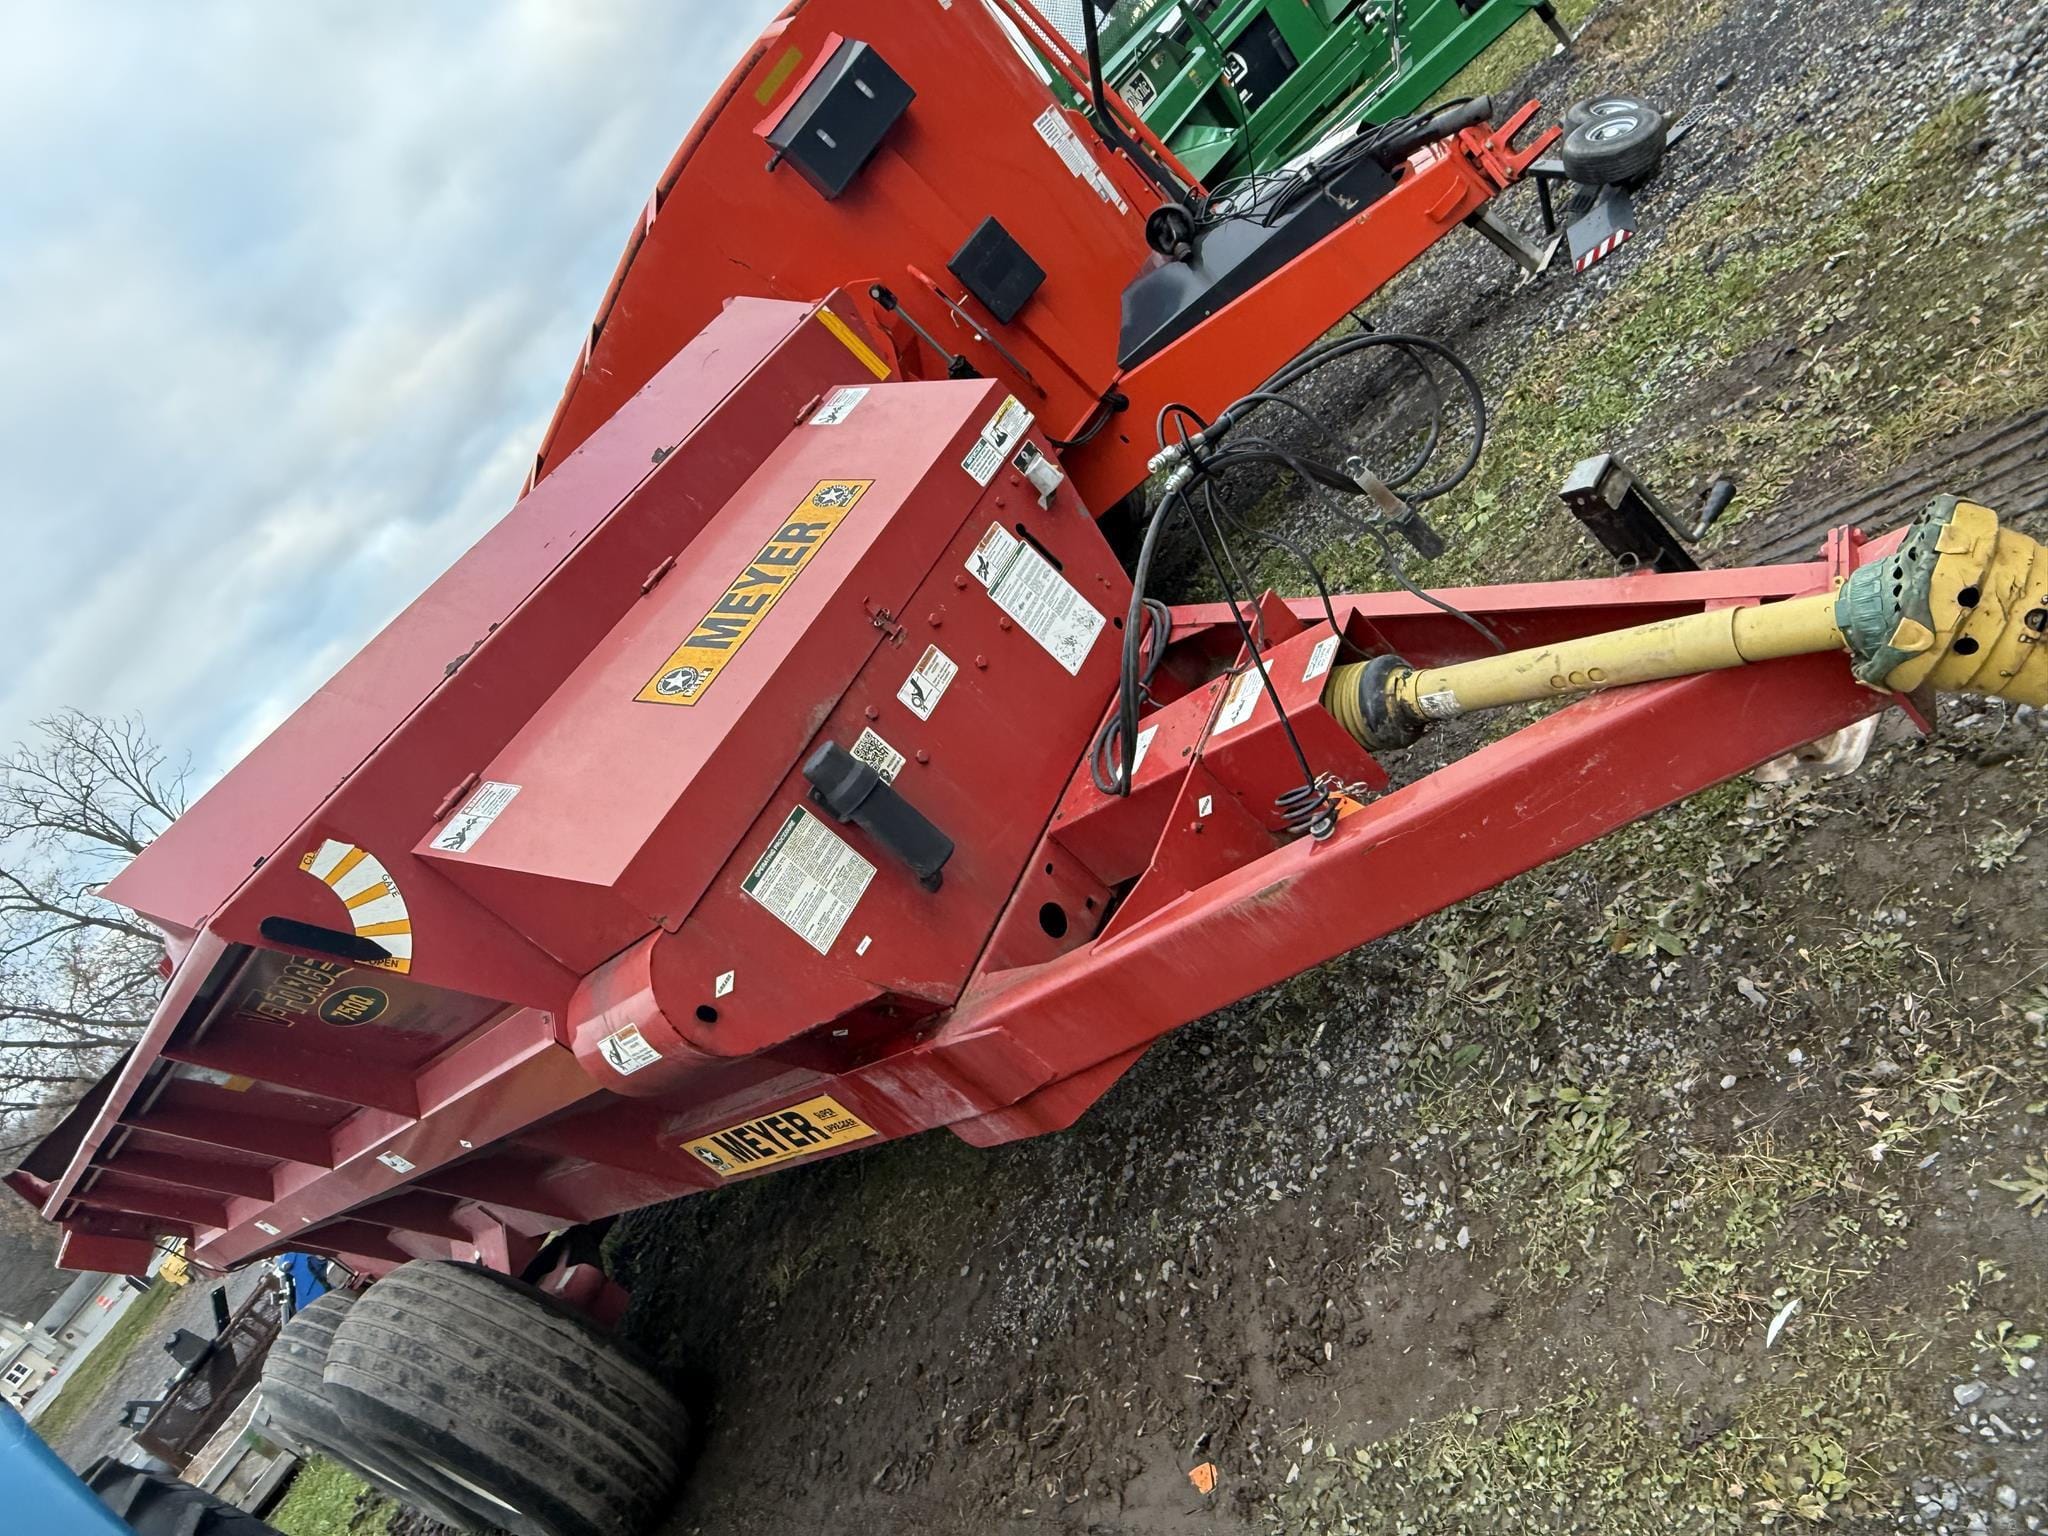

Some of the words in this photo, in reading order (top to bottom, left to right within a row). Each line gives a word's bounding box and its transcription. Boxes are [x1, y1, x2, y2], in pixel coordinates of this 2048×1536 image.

[684, 520, 831, 650] MEYER
[754, 848, 776, 878] OPERATING
[773, 819, 796, 850] PROCEDURE
[382, 873, 400, 898] GATE
[369, 959, 399, 968] OPEN
[710, 1111, 832, 1164] MEYER
